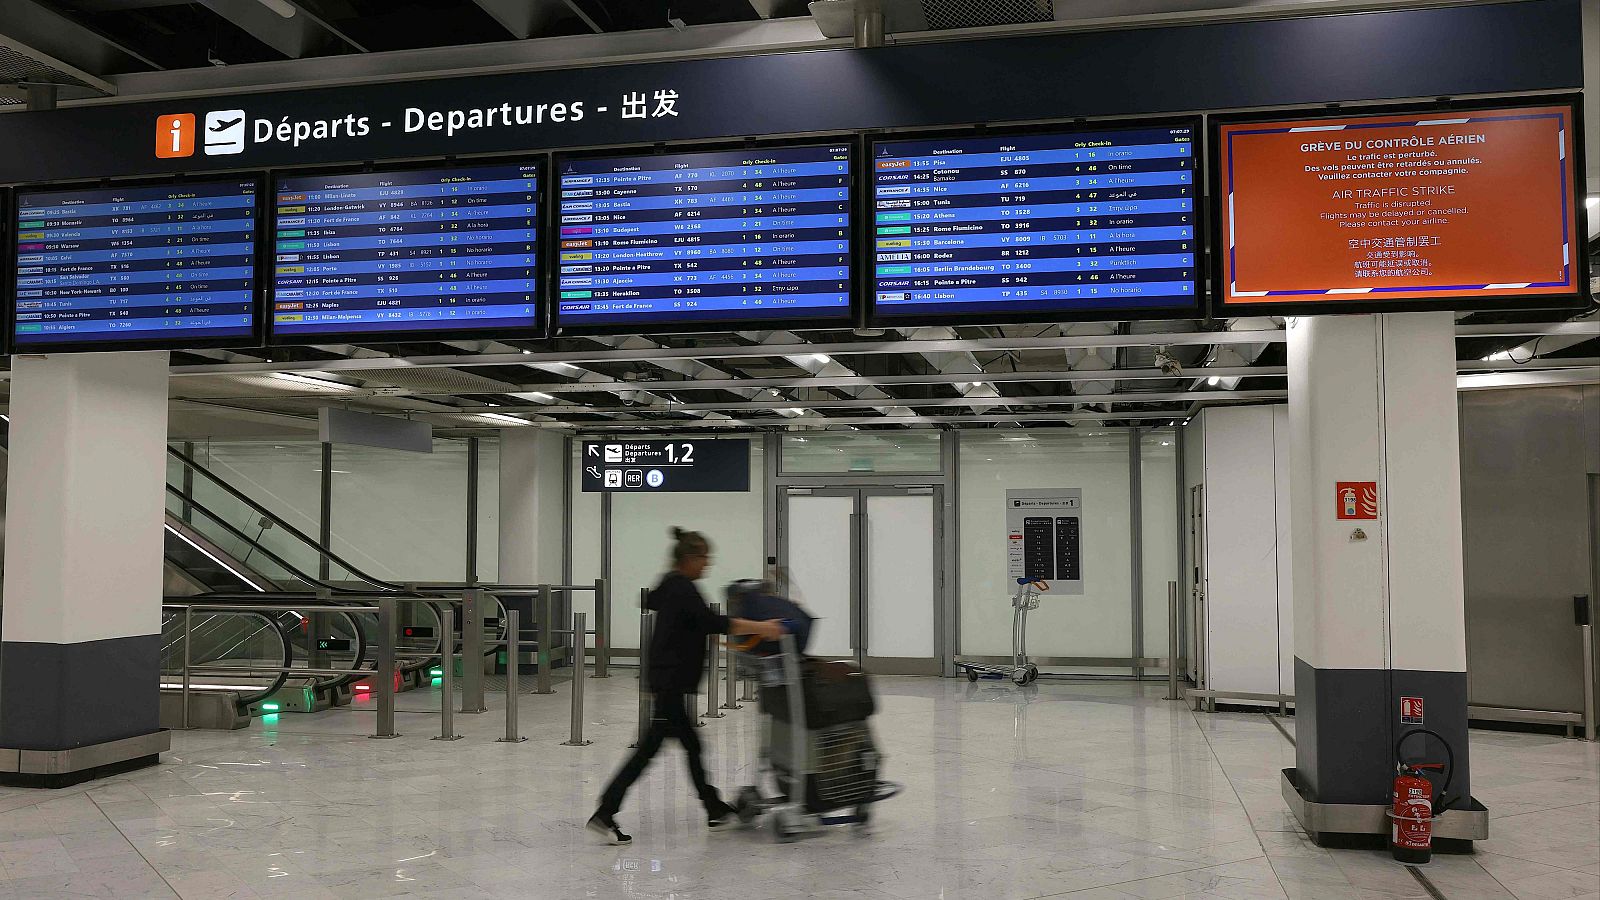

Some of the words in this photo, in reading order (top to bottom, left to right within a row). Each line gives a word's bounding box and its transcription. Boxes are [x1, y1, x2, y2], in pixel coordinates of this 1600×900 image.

[254, 115, 370, 146] Départs
[403, 100, 584, 136] Departures
[620, 89, 679, 119] 出发
[1301, 141, 1341, 152] GRÈVE
[1345, 141, 1362, 150] DU
[1366, 136, 1434, 149] CONTRÔLE
[1438, 134, 1485, 145] AÉRIEN
[1398, 150, 1437, 159] perturbé.
[1341, 163, 1375, 171] peuvent
[1447, 157, 1482, 165] annulés.
[1419, 167, 1468, 176] compagnie.
[1332, 190, 1352, 199] AIR
[1356, 188, 1408, 198] TRAFFIC
[1412, 185, 1455, 195] STRIKE
[1391, 199, 1432, 208] disrupted.
[1381, 209, 1414, 217] delayed
[1428, 207, 1469, 215] cancelled.
[1349, 236, 1441, 248] 空中交通管制罢工
[665, 444, 694, 463] 1,2
[652, 474, 658, 483] B
